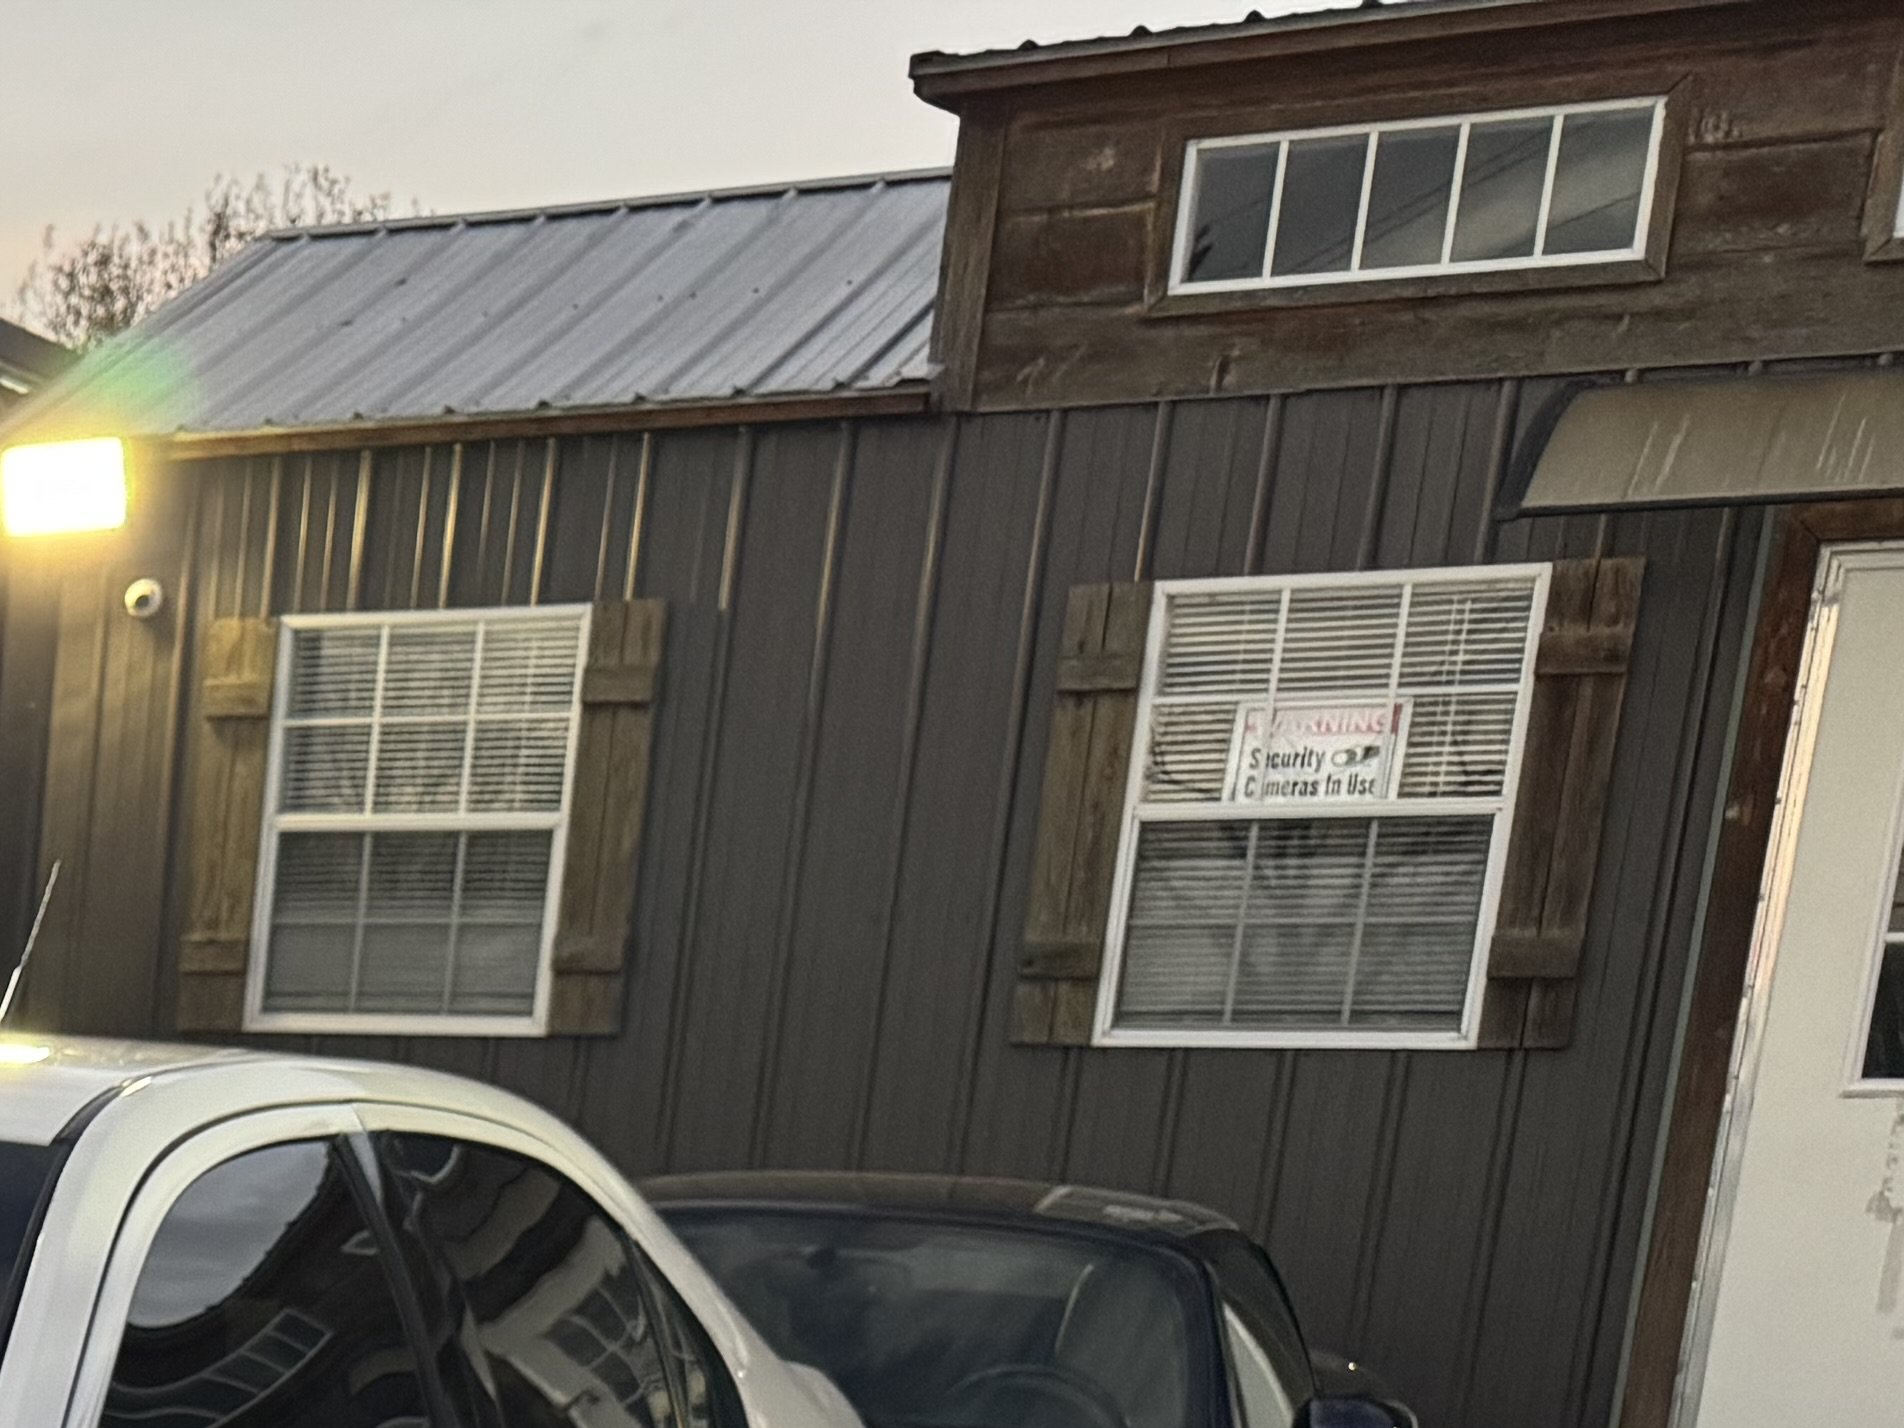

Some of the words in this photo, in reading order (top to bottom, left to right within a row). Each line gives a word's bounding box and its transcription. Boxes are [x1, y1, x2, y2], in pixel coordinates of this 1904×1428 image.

[1248, 746, 1326, 773] Scurity
[1243, 774, 1320, 798] Cmeras
[1324, 772, 1342, 796] In
